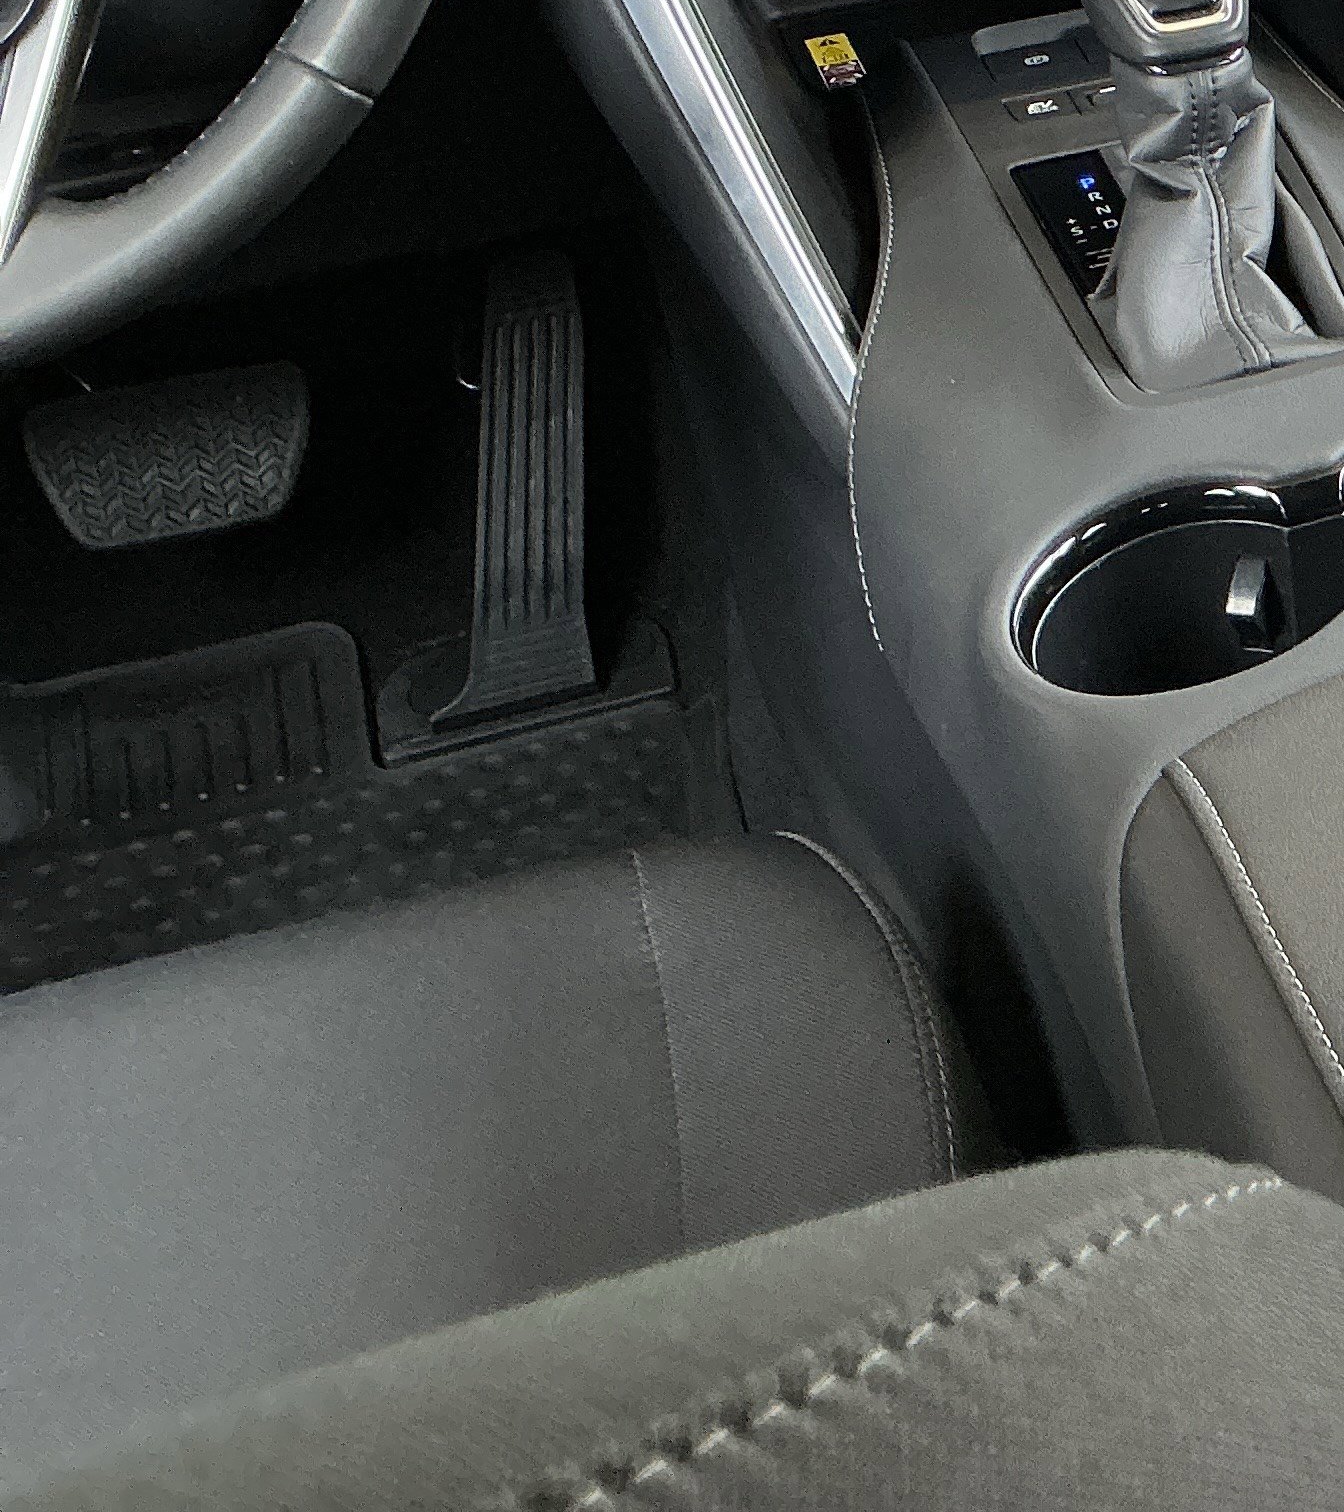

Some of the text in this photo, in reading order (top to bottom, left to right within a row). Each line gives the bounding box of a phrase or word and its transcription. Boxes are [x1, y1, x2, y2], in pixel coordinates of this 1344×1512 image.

[1079, 177, 1095, 190] P
[1087, 191, 1104, 202] R
[1095, 204, 1112, 216] N
[1103, 218, 1119, 231] D
[1070, 225, 1084, 237] S
